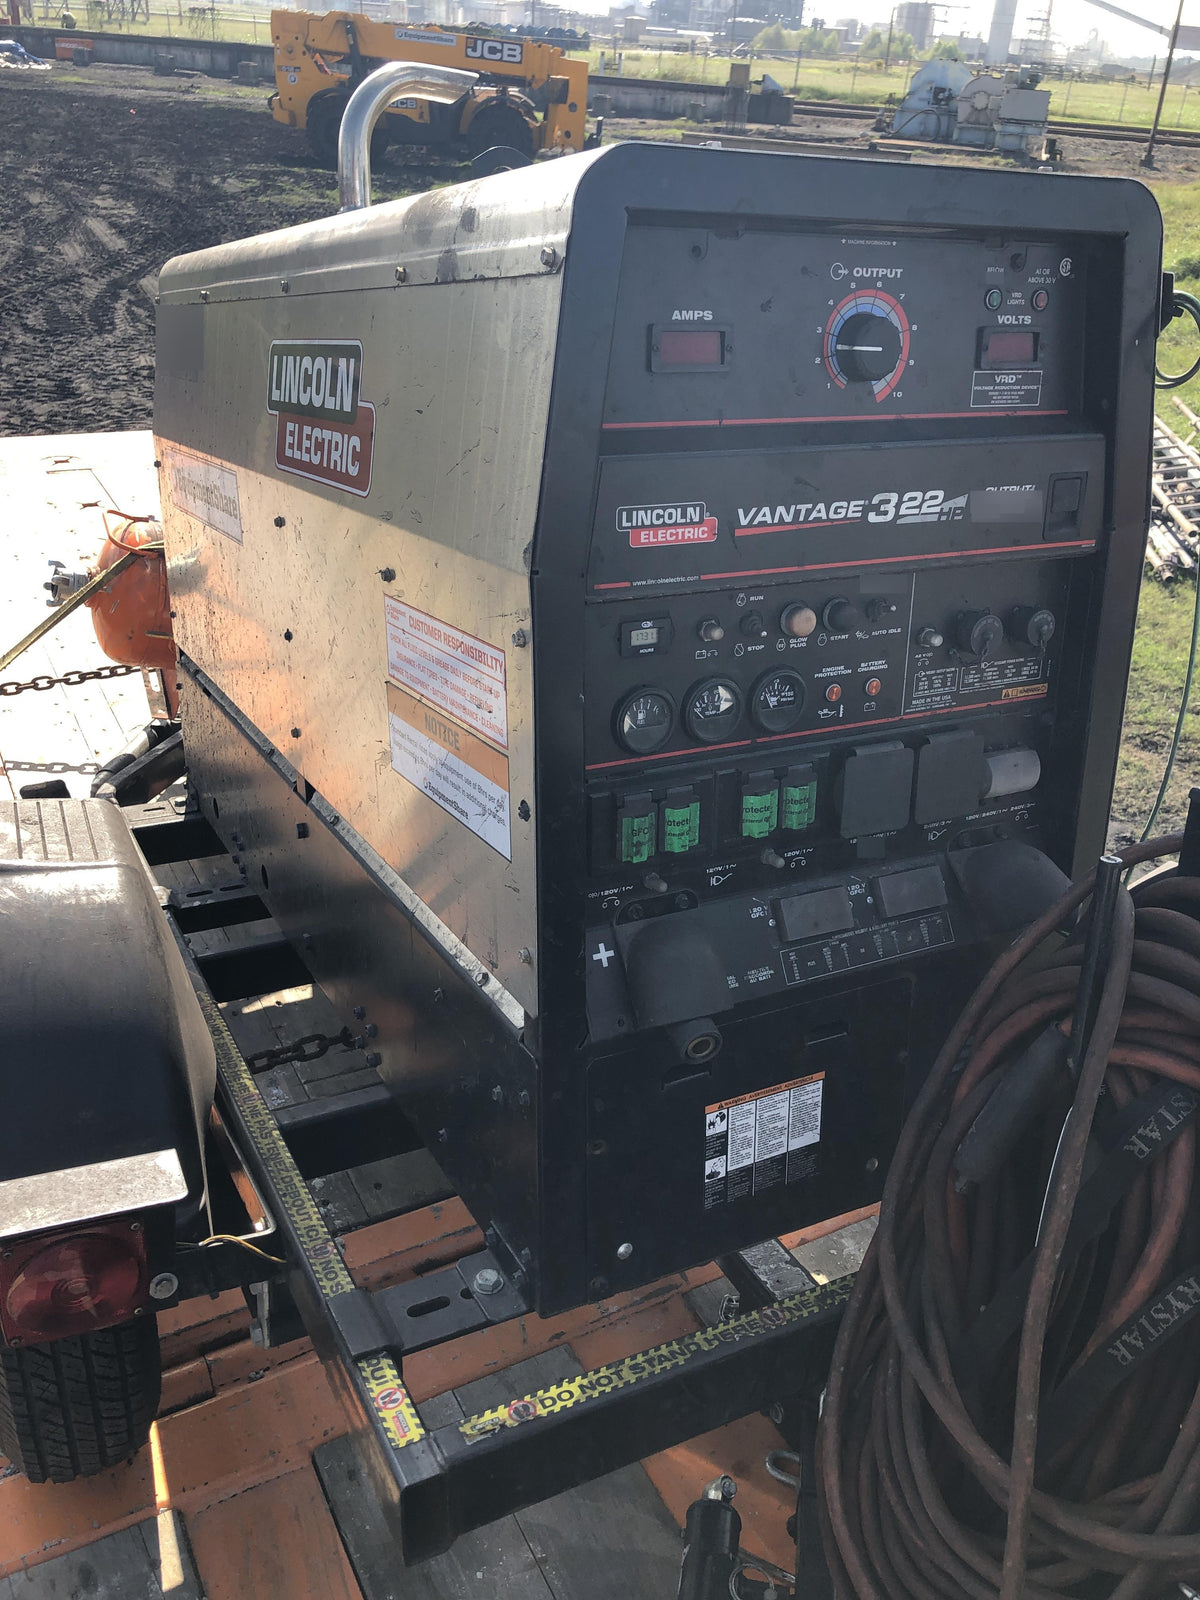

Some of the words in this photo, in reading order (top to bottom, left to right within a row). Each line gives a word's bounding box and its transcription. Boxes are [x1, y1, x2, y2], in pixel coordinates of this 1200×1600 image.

[466, 39, 522, 63] JCB
[853, 267, 903, 278] OUTPUT
[671, 310, 714, 321] AMPS
[997, 315, 1032, 325] VOLTS
[271, 355, 355, 413] LINCOLN
[285, 421, 361, 477] ELECTRIC
[622, 506, 700, 527] LINCOLN
[737, 500, 865, 526] VANTAGE
[867, 490, 945, 523] 322
[640, 527, 708, 543] ELECTRIC
[632, 575, 700, 587] www.lincolnelectric.com
[408, 614, 441, 643] CUSTOMER
[442, 631, 503, 675] RESPONSIBILITY
[747, 644, 765, 652] STOP
[434, 656, 449, 672] GREASE
[449, 664, 461, 679] DAILY
[462, 671, 478, 688] BEFORE
[814, 669, 852, 679] PROTECTION
[822, 665, 845, 673] ENGINE
[857, 664, 888, 673] CHARGING
[860, 660, 886, 668] BATTERY
[912, 697, 926, 705] MADE
[941, 694, 951, 702] USA
[423, 711, 460, 752] NOTICE
[480, 715, 503, 738] CLEANING
[449, 777, 461, 794] result
[428, 781, 468, 821] EquipmentShare
[229, 1069, 250, 1095] HERE
[246, 1103, 263, 1120] NE
[724, 1096, 746, 1106] WARNING
[253, 1117, 273, 1141] PAS
[263, 1139, 290, 1176] TENEZ
[279, 1173, 313, 1224] DEBOUT
[302, 1223, 322, 1243] ICI
[318, 1258, 340, 1282] NO
[538, 1386, 576, 1411] DO
[576, 1368, 624, 1396] NOT
[628, 1339, 697, 1377] STAND
